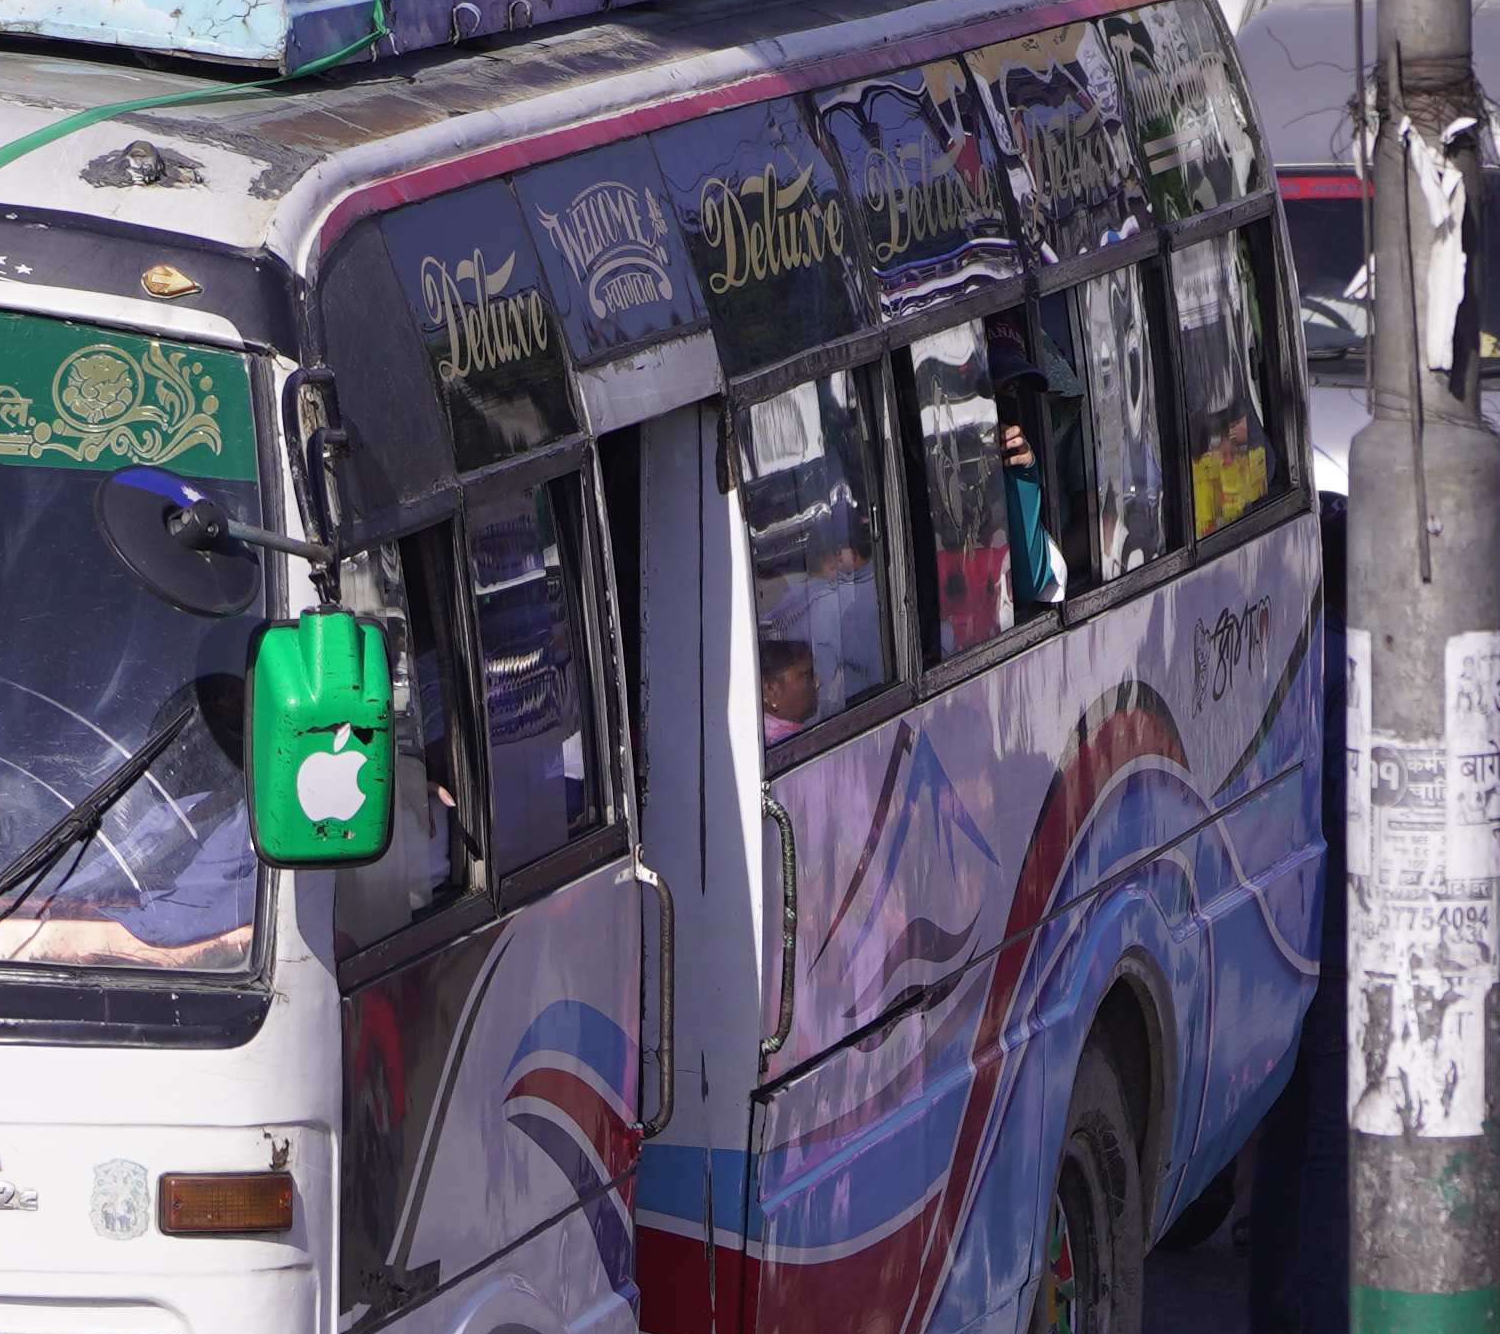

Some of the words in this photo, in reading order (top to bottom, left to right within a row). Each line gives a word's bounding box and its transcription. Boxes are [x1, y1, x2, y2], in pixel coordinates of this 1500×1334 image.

[534, 188, 658, 290] WELCOME
[700, 162, 846, 297] Deluxe
[419, 249, 550, 383] Deluxe
